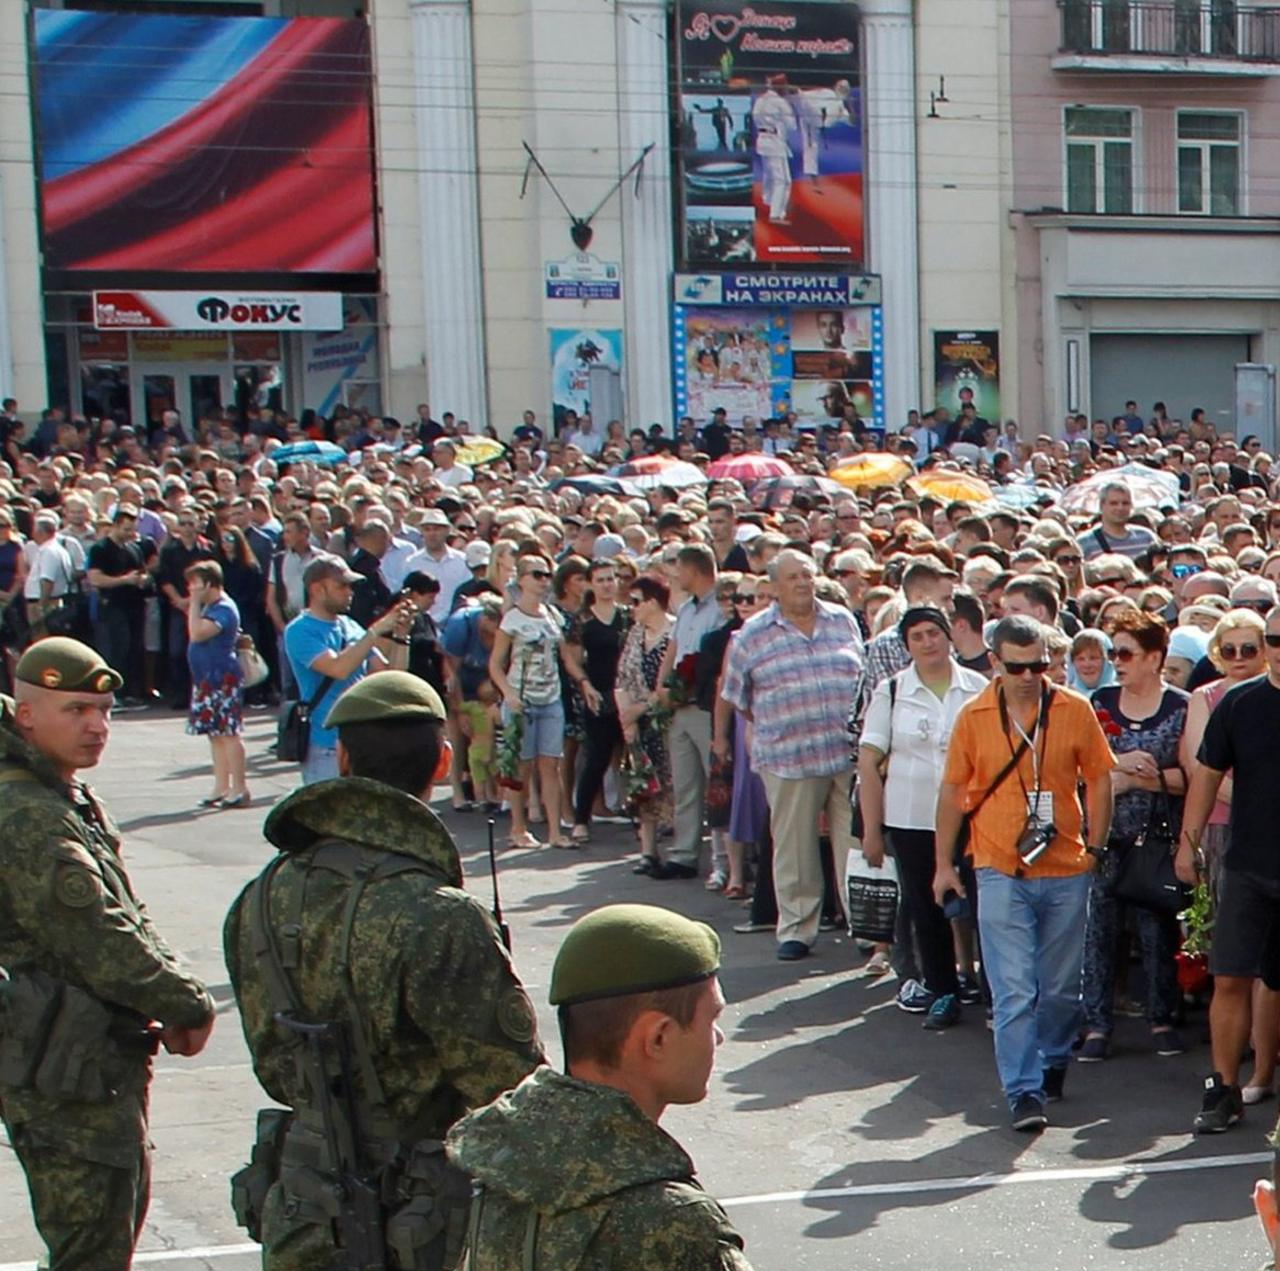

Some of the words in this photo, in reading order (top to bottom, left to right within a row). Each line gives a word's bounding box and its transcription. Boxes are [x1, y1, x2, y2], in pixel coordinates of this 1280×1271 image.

[735, 276, 839, 289] СМОТРИТЕ
[725, 290, 755, 303] НА
[758, 291, 848, 304] ЭКРАНАХ
